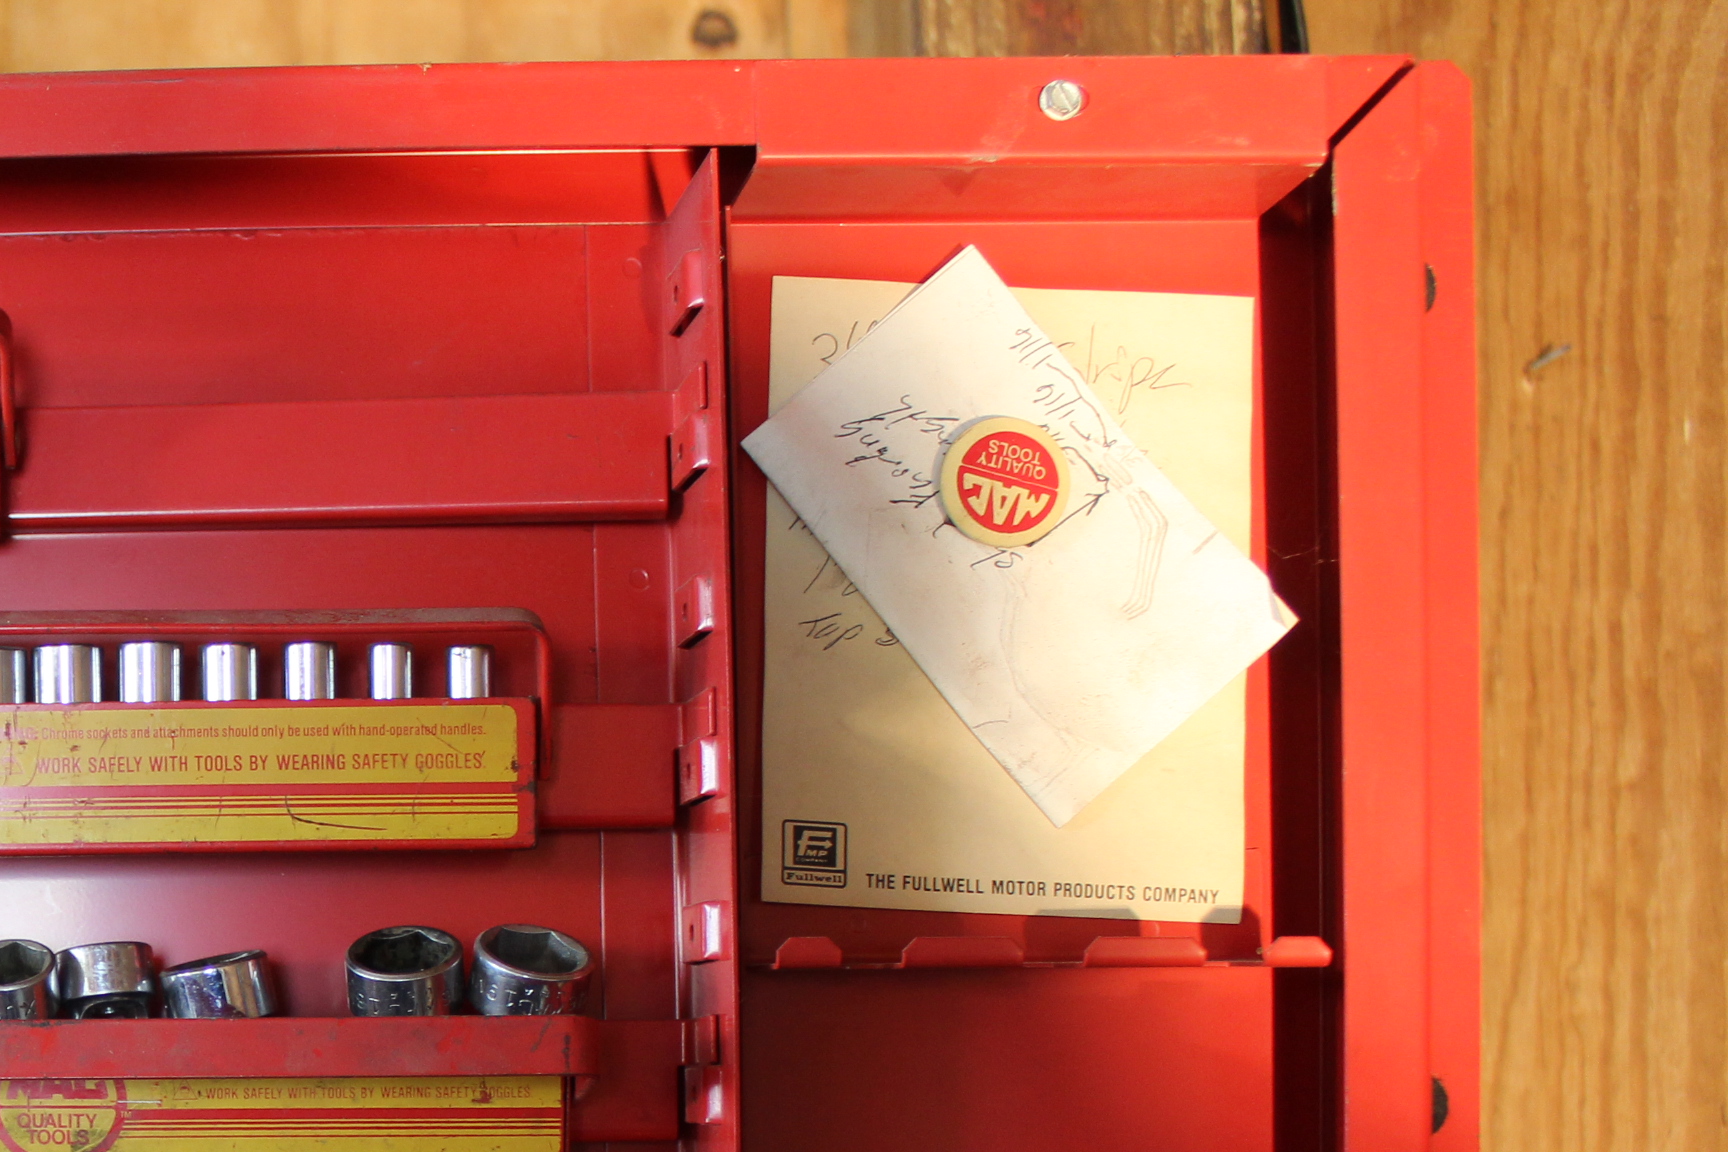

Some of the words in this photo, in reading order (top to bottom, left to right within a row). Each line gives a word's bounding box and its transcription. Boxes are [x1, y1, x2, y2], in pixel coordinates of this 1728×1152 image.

[988, 439, 1041, 464] TOOLS
[976, 452, 1046, 480] QUALITY
[963, 473, 1051, 525] MAC
[41, 727, 83, 739] Chrome
[86, 727, 128, 740] sockets
[130, 726, 150, 738] and
[153, 726, 219, 738] attachments
[222, 725, 259, 737] should
[261, 725, 285, 739] only
[287, 725, 301, 736] be
[303, 725, 329, 736] used
[332, 723, 357, 736] with
[359, 723, 437, 738] hand-operated
[440, 723, 486, 735] handles.
[37, 756, 81, 773] WORK
[88, 756, 142, 773] SAFELY
[149, 755, 188, 772] WITH
[194, 755, 243, 772] TOOLS
[249, 754, 268, 771] BY
[276, 754, 346, 770] WEARING
[352, 753, 409, 770] SAFETY
[786, 872, 842, 883] Fullwell
[865, 873, 896, 890] THE
[902, 875, 984, 895] FULLWELL
[991, 879, 1046, 897] MOTOR
[1053, 882, 1135, 901] PRODUCTS
[1142, 886, 1219, 904] COMPANY
[206, 1088, 239, 1099] WORK
[244, 1087, 283, 1099] SAFELY
[288, 1087, 317, 1099] WITH
[323, 1087, 356, 1099] TOOLS
[361, 1087, 374, 1099] BY
[381, 1087, 431, 1099] WEARING
[435, 1086, 476, 1098] SAFETY
[17, 1113, 97, 1129] QUALITY
[27, 1129, 90, 1145] TOOLS
